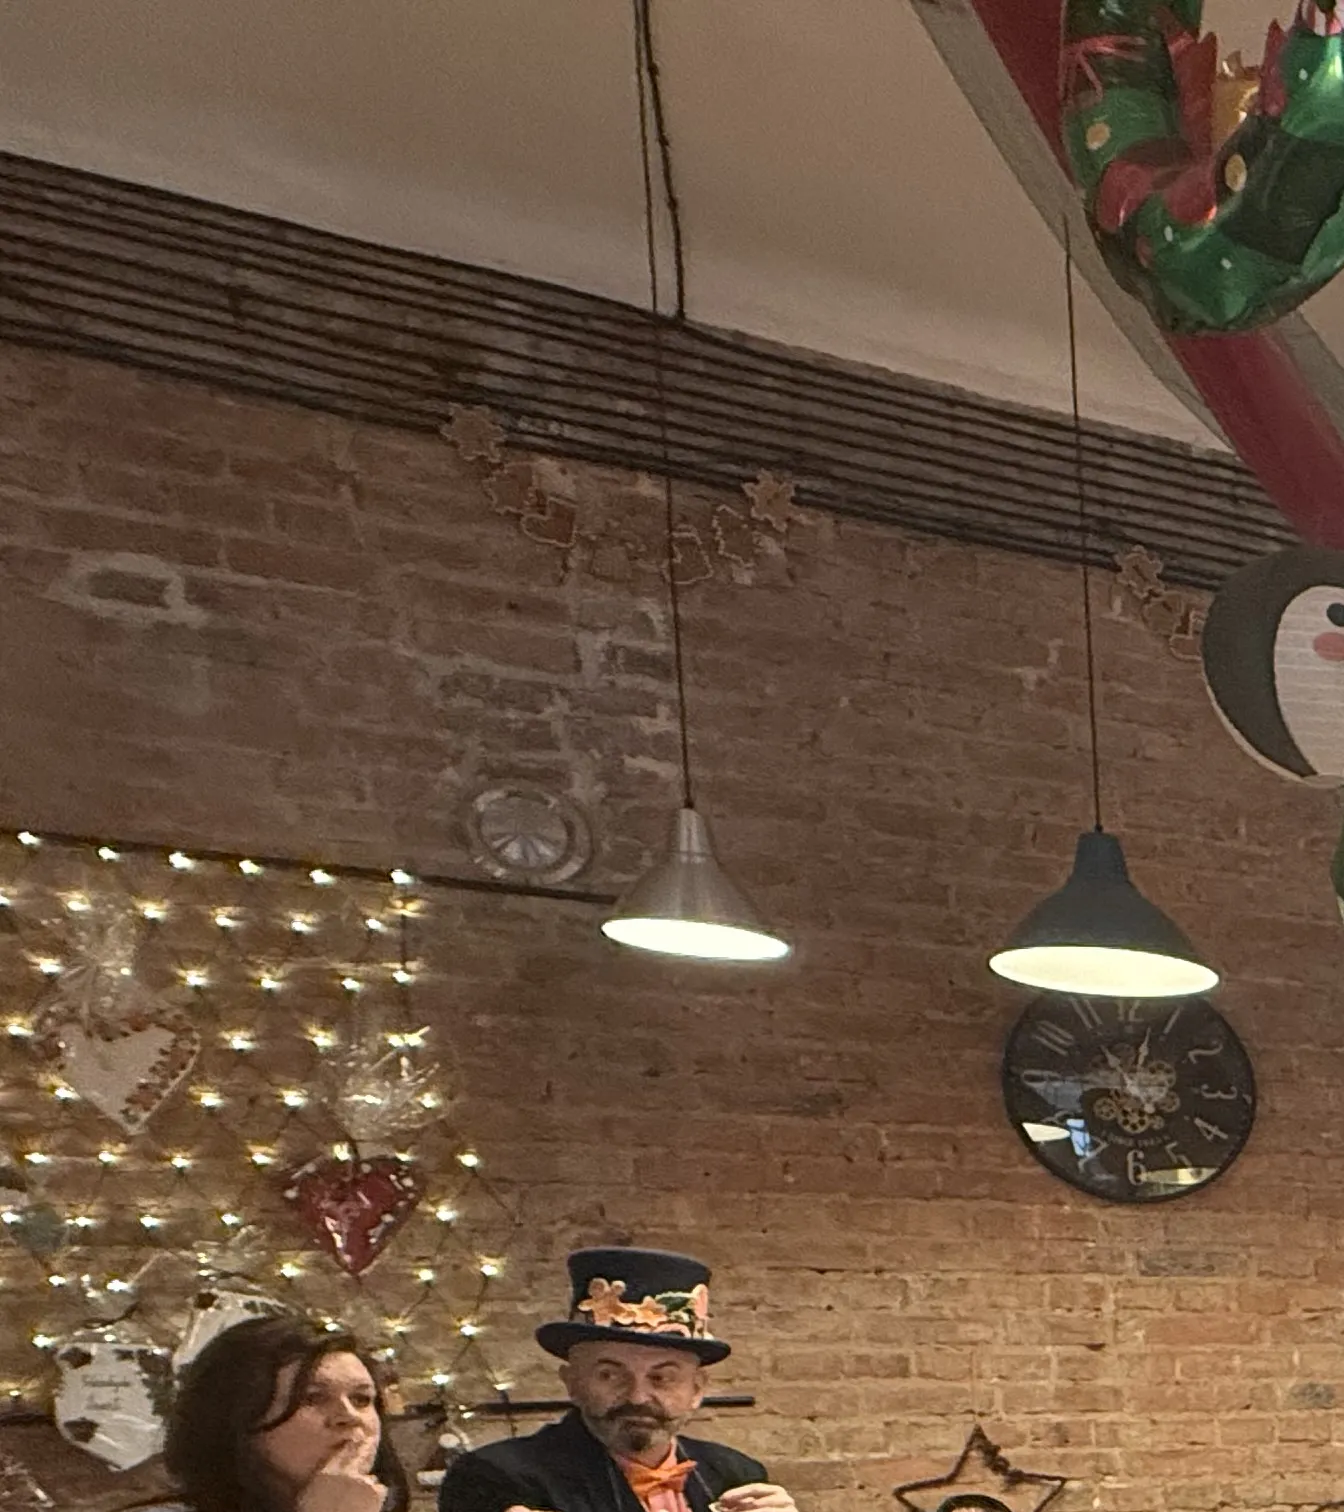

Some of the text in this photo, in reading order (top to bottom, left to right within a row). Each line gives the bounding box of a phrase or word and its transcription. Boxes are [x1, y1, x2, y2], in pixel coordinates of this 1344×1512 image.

[1200, 1083, 1238, 1100] 3
[1193, 1117, 1229, 1141] 4
[1126, 1149, 1148, 1186] 6
